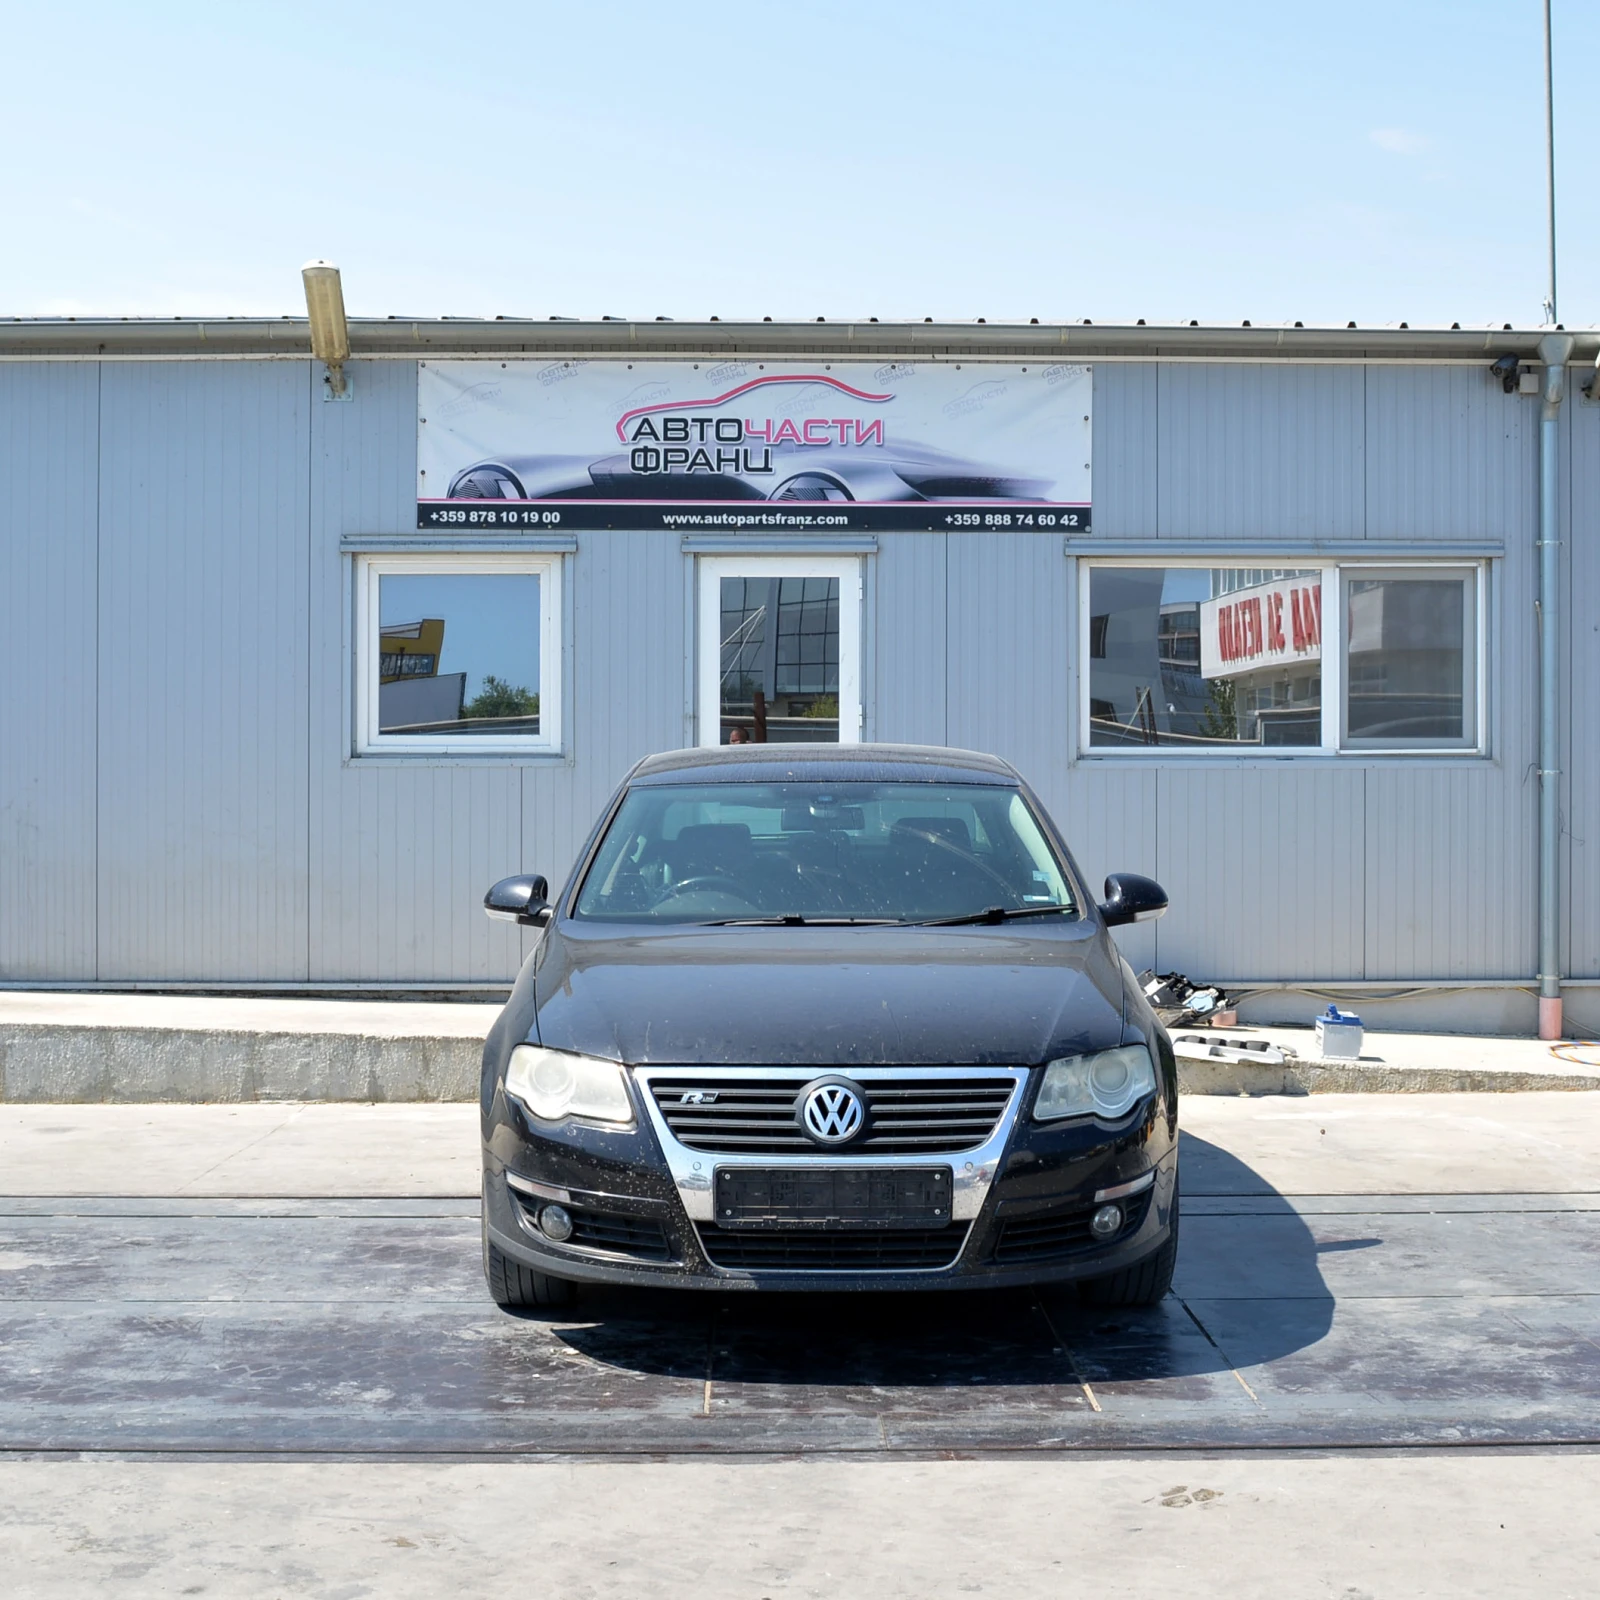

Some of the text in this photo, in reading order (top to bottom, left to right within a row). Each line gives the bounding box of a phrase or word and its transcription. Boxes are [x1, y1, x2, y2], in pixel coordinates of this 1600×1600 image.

[631, 417, 882, 444] АВТОЧАСТИ
[630, 446, 773, 474] ФРАНЦ
[430, 511, 560, 523] +359 878 10 19 00
[662, 513, 848, 527] www.autopartsfranz.com
[945, 513, 1079, 526] +359 888 74 60 42
